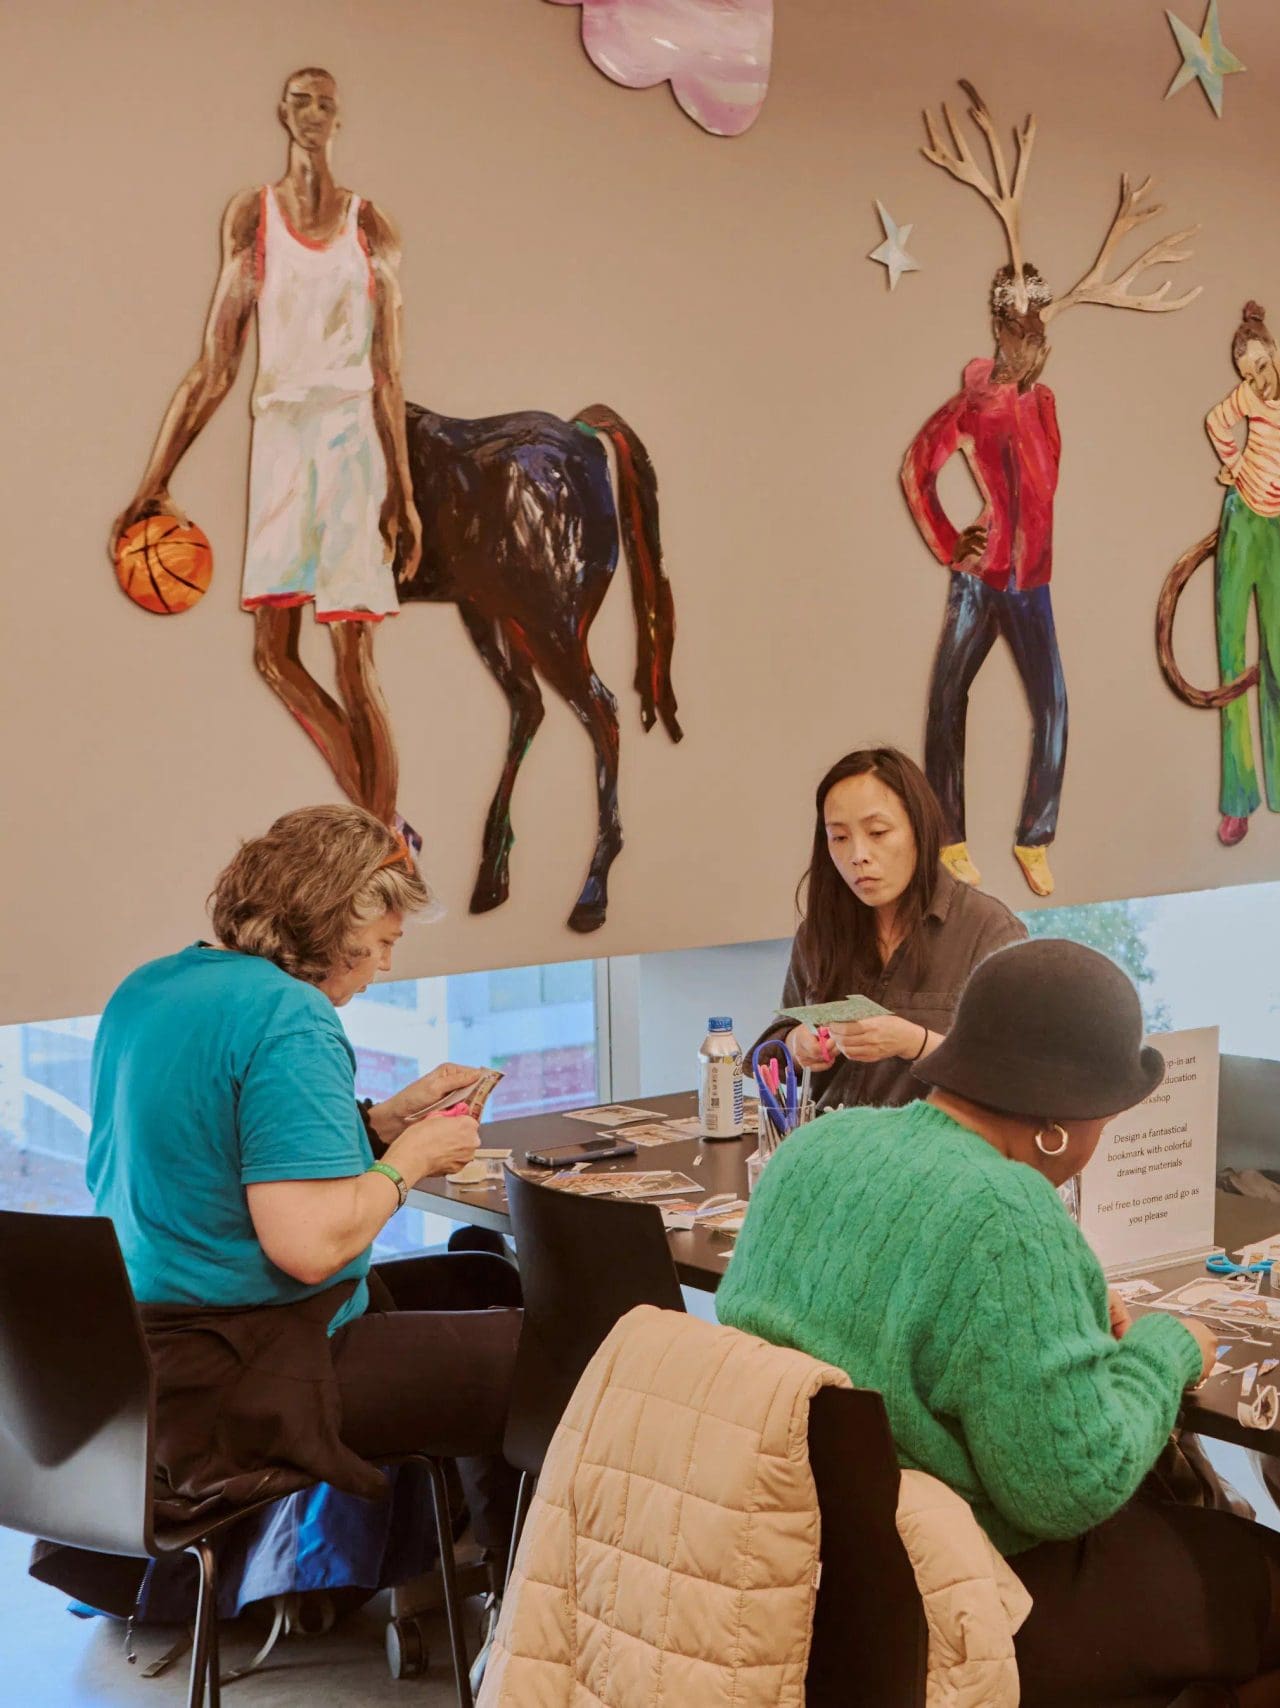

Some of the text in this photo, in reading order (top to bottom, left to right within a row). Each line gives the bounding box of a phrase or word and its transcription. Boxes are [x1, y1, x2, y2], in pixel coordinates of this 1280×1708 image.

[1185, 1056, 1196, 1064] art
[1162, 1073, 1197, 1085] ducation
[1141, 1094, 1171, 1105] orkshop
[1113, 1132, 1141, 1144] Design
[1148, 1123, 1188, 1138] fantastical
[1107, 1139, 1193, 1162] bookmark with colorful
[1116, 1158, 1183, 1178] drawing materials
[1097, 1187, 1200, 1214] Feel free to come and go as
[1128, 1210, 1169, 1226] you please
